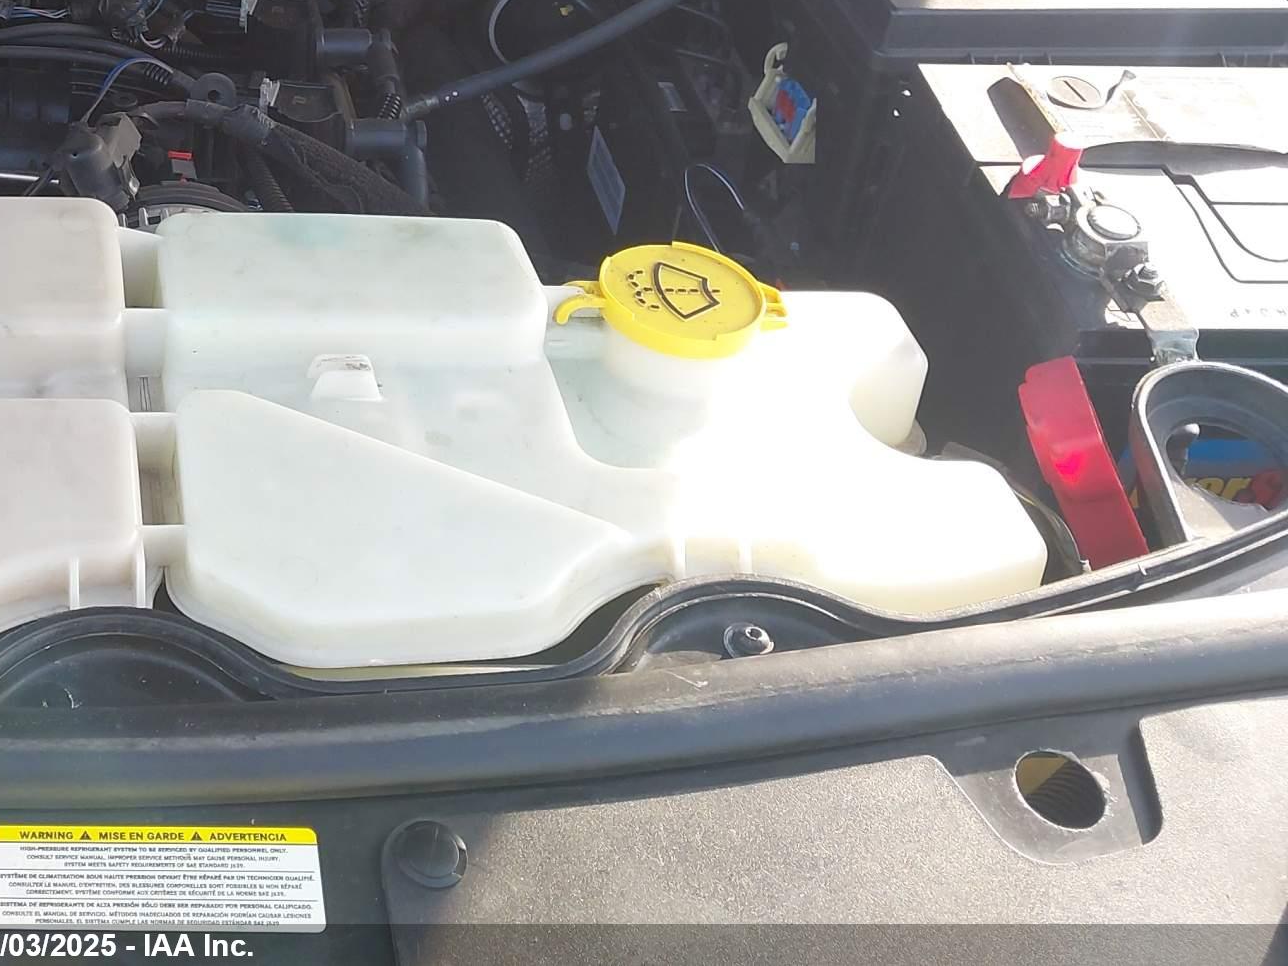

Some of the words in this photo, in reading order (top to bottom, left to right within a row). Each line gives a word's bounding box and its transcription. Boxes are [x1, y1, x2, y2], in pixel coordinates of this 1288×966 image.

[19, 831, 74, 840] WARNING
[99, 831, 126, 840] MISE
[129, 831, 144, 840] EN
[147, 832, 185, 840] GARDE
[209, 832, 287, 841] ADVERTENCIA
